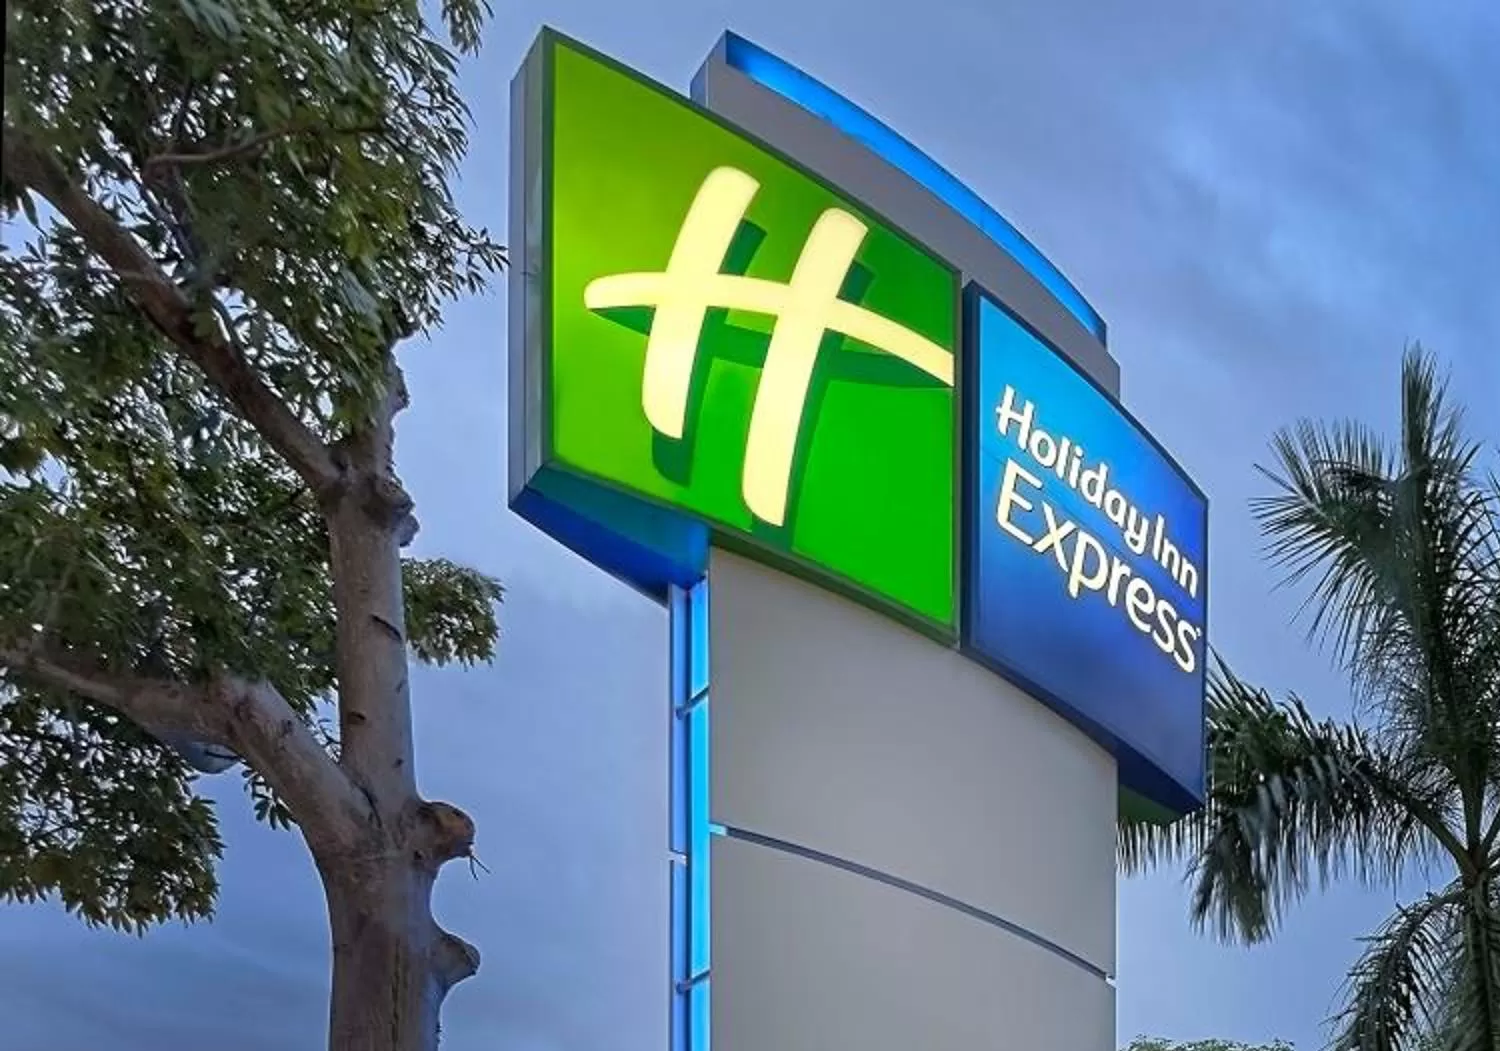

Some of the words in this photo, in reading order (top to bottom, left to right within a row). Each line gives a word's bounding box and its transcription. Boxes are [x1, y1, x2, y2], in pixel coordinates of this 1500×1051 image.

[995, 384, 1149, 555] Holiday
[1153, 514, 1198, 599] Inn
[996, 457, 1201, 673] Express
